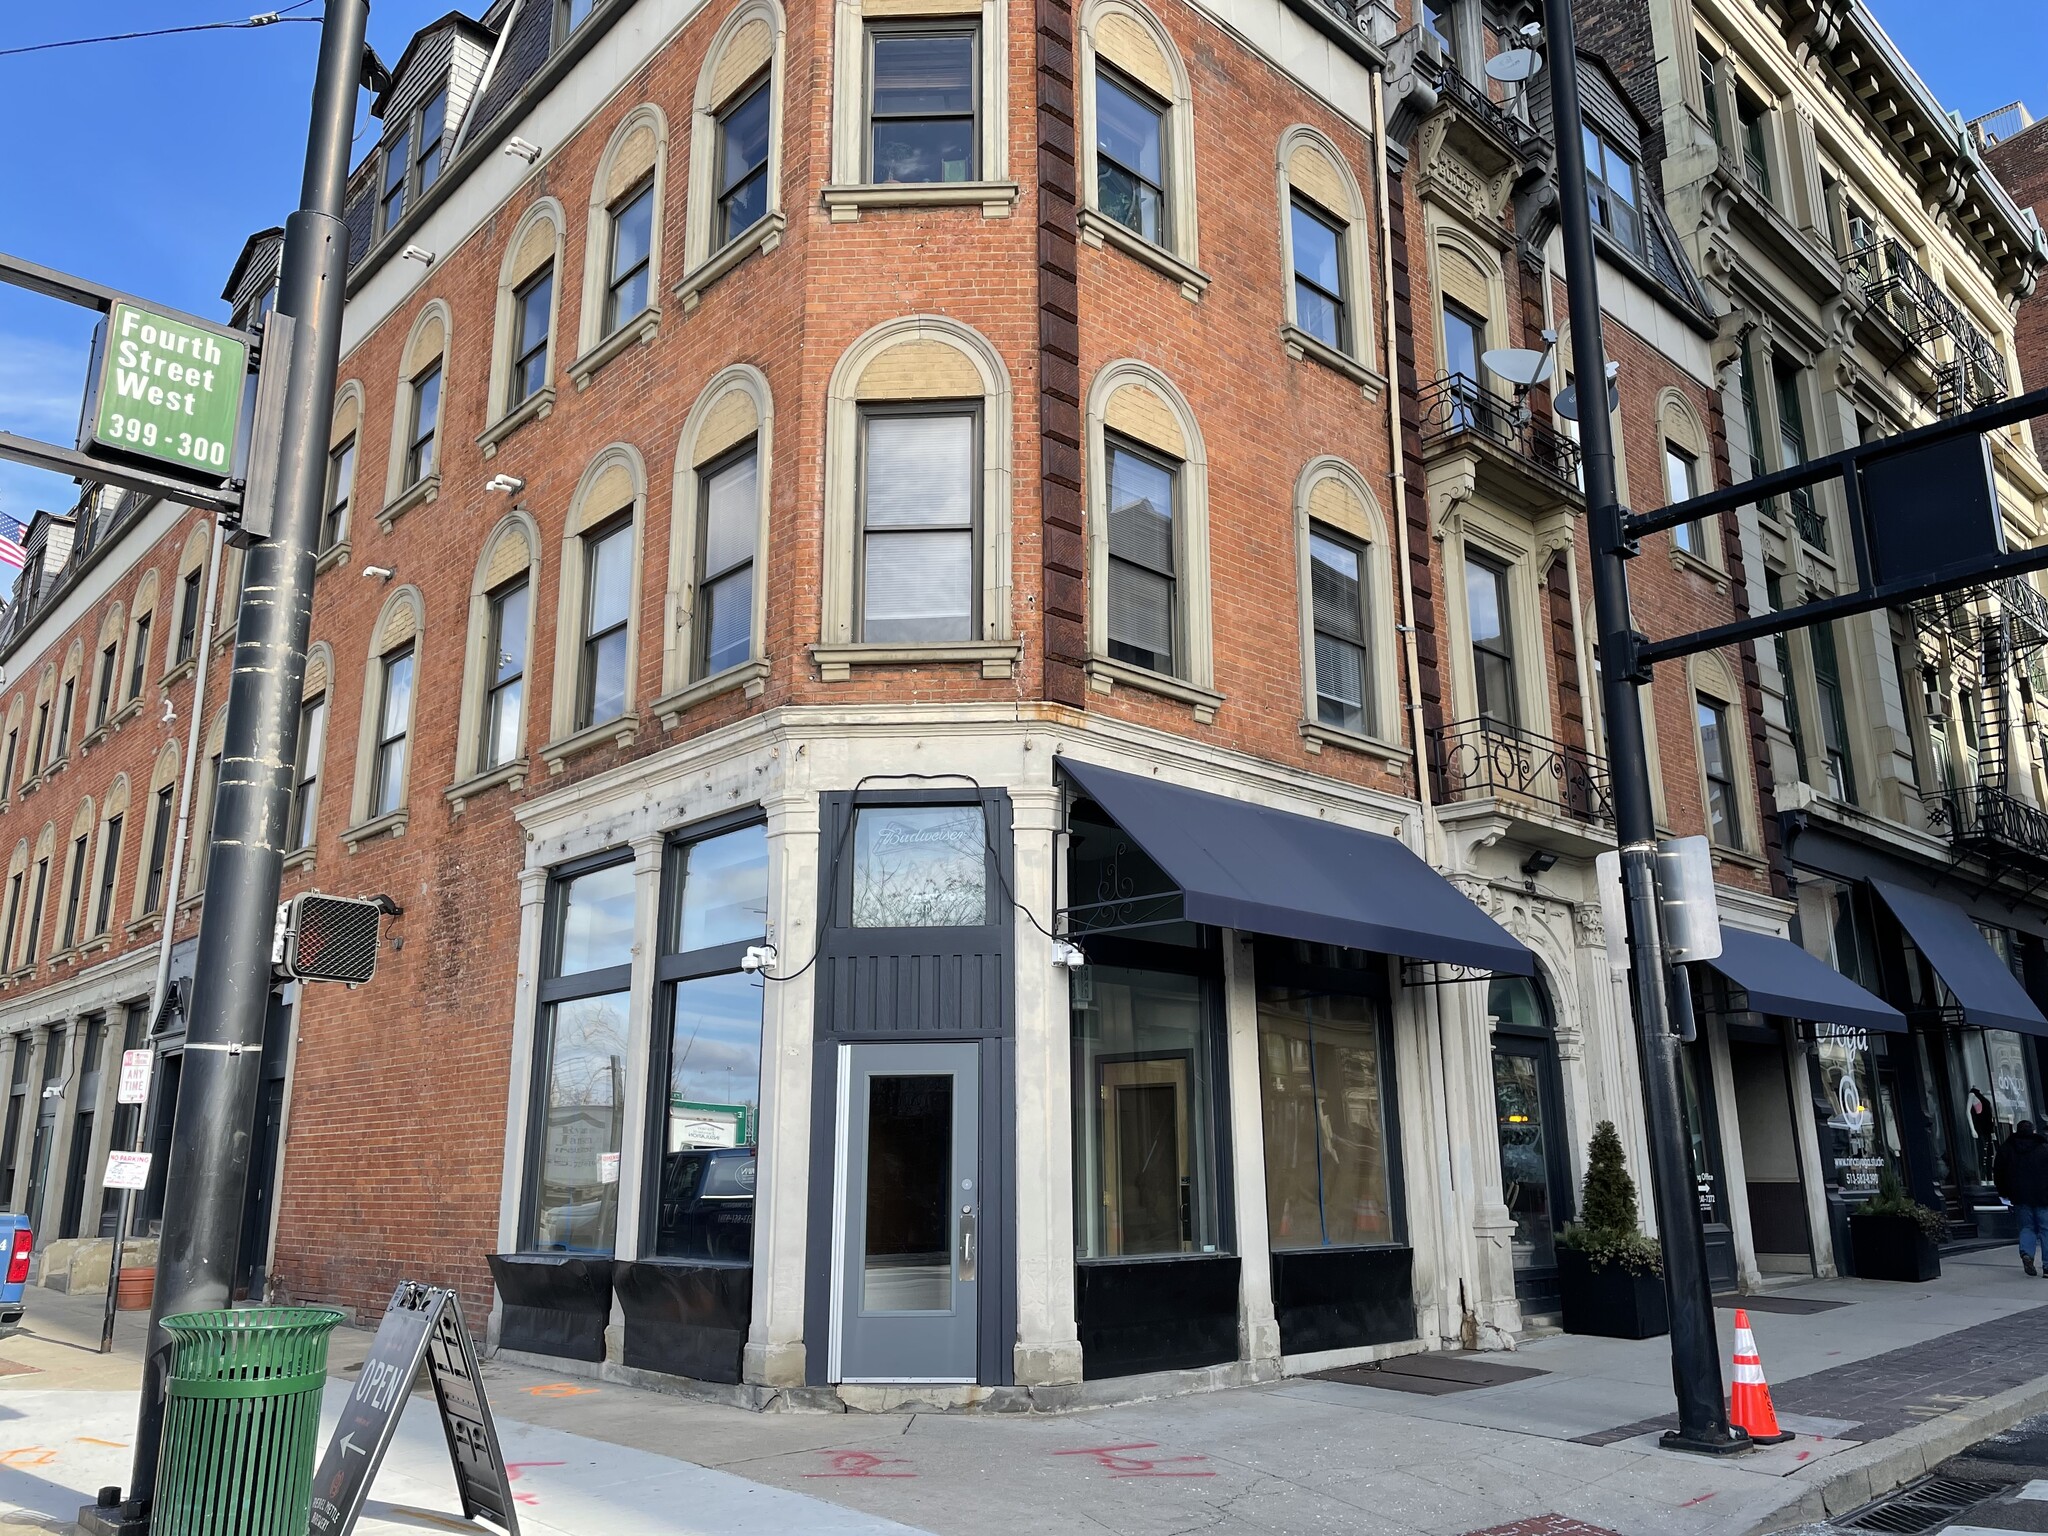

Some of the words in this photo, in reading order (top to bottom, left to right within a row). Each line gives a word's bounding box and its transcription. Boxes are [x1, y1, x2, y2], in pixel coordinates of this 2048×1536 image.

[121, 311, 221, 366] Fourth
[118, 340, 215, 392] Street
[115, 368, 195, 416] West
[878, 827, 965, 845] Budweiser
[125, 1081, 143, 1092] TIME
[127, 1069, 144, 1080] ANY
[120, 1155, 149, 1163] PARKING
[355, 1358, 404, 1413] OPEN
